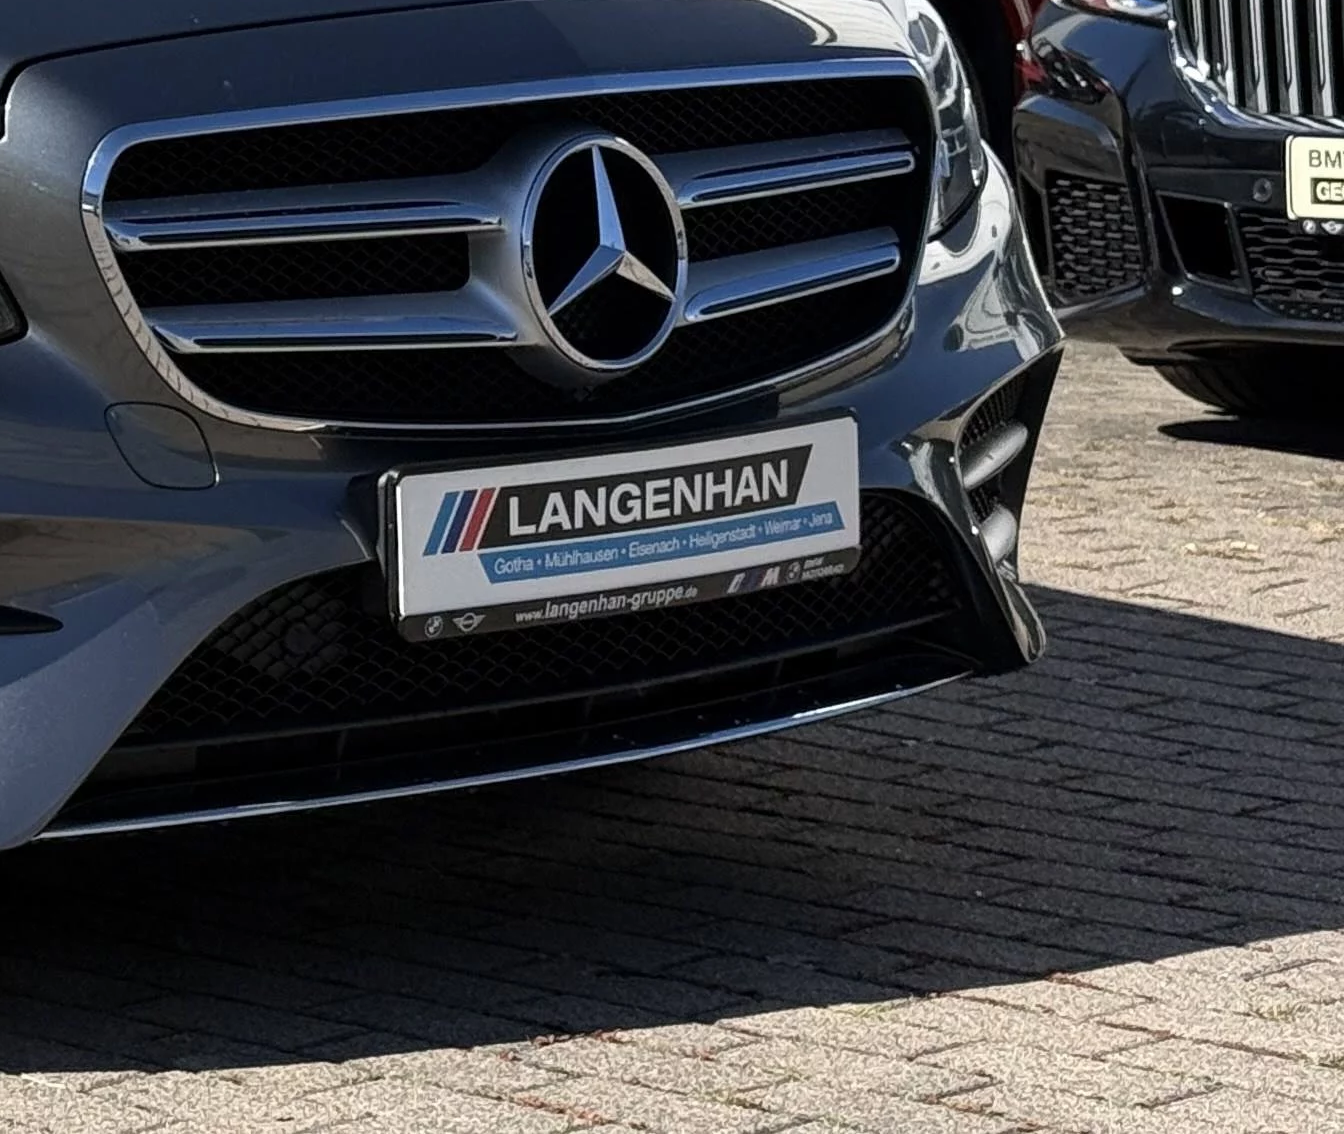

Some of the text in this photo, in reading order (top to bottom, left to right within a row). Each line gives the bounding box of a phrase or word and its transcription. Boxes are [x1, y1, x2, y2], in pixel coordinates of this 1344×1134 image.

[1308, 149, 1344, 169] BM
[1316, 180, 1344, 202] GE
[509, 459, 789, 537] LANGENHAN
[494, 512, 833, 575] Gotha Mühlhausen Eisenach Heiligenstadt Weimar Jena
[515, 585, 698, 623] www.langenhan-gruppe.de
